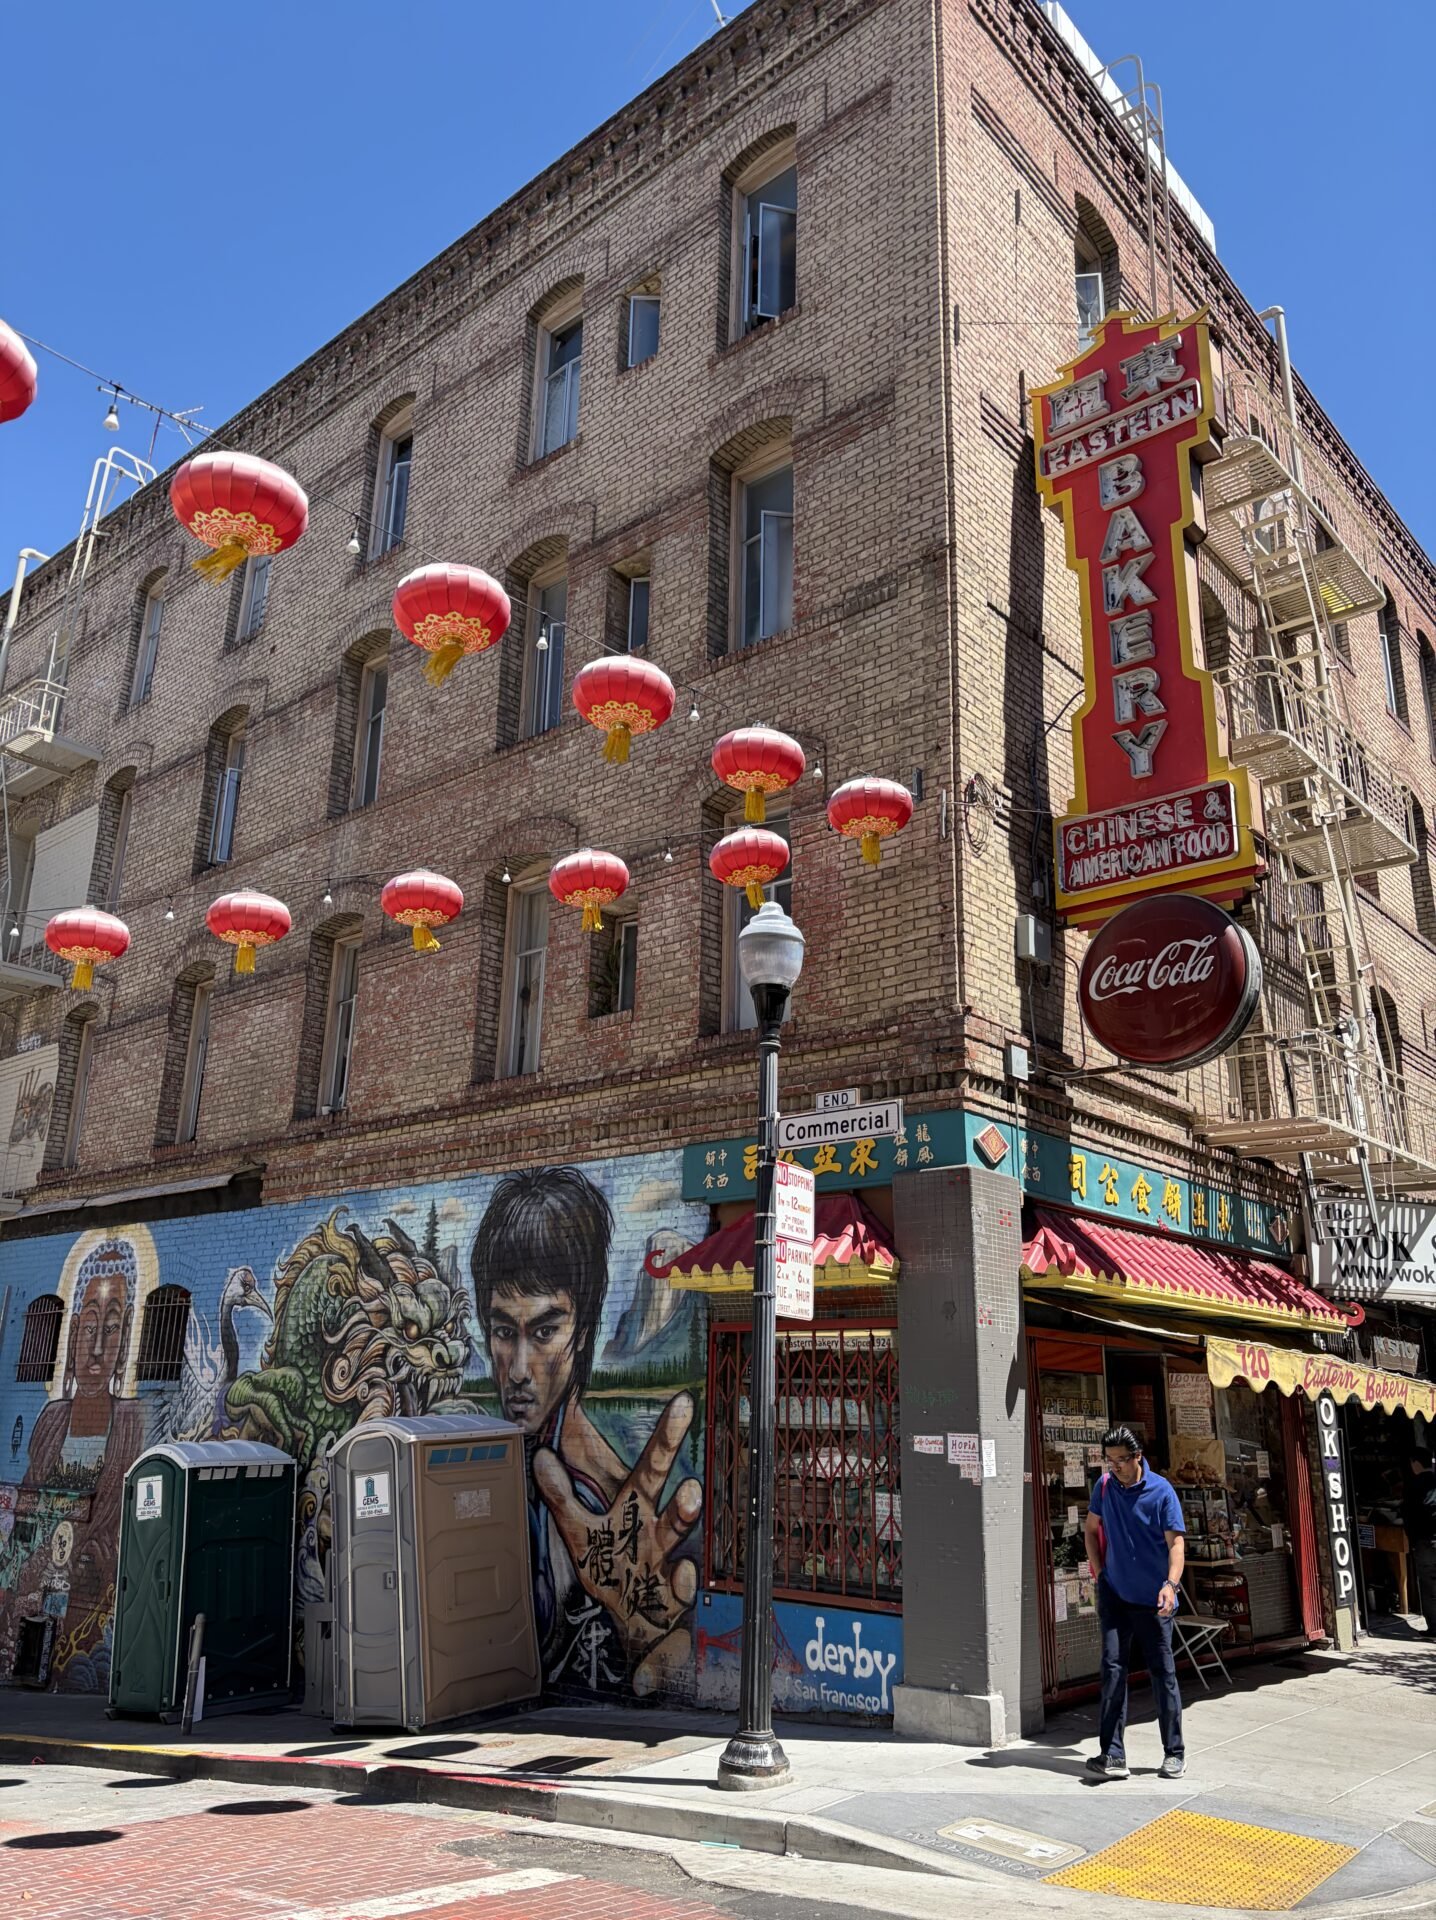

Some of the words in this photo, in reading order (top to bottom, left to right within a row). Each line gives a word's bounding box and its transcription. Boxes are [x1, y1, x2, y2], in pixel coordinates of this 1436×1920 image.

[1049, 388, 1196, 474] EASTERN
[1098, 454, 1168, 779] BAKERY
[1065, 798, 1194, 855] CHINESE
[1203, 790, 1227, 820] &
[1069, 837, 1171, 887] AMERICAN
[1172, 822, 1230, 864] FOOD
[1089, 934, 1217, 1001] Coca-Cola
[823, 1092, 849, 1107] END
[785, 1109, 889, 1141] Commercial
[776, 1162, 787, 1184] NO
[788, 1172, 813, 1192] STOPPING
[1325, 1203, 1352, 1222] the
[776, 1241, 786, 1262] NO
[787, 1247, 812, 1266] PARKING
[1327, 1226, 1415, 1262] WOK
[776, 1285, 787, 1299] TUE
[795, 1288, 810, 1303] THUR
[1236, 1345, 1269, 1380] 720
[1304, 1356, 1359, 1390] Eastern
[1366, 1372, 1408, 1407] Bakery
[1327, 1472, 1353, 1599] SHOP
[805, 1616, 896, 1710] derby
[794, 1679, 818, 1701] San
[820, 1682, 880, 1713] Francisco
